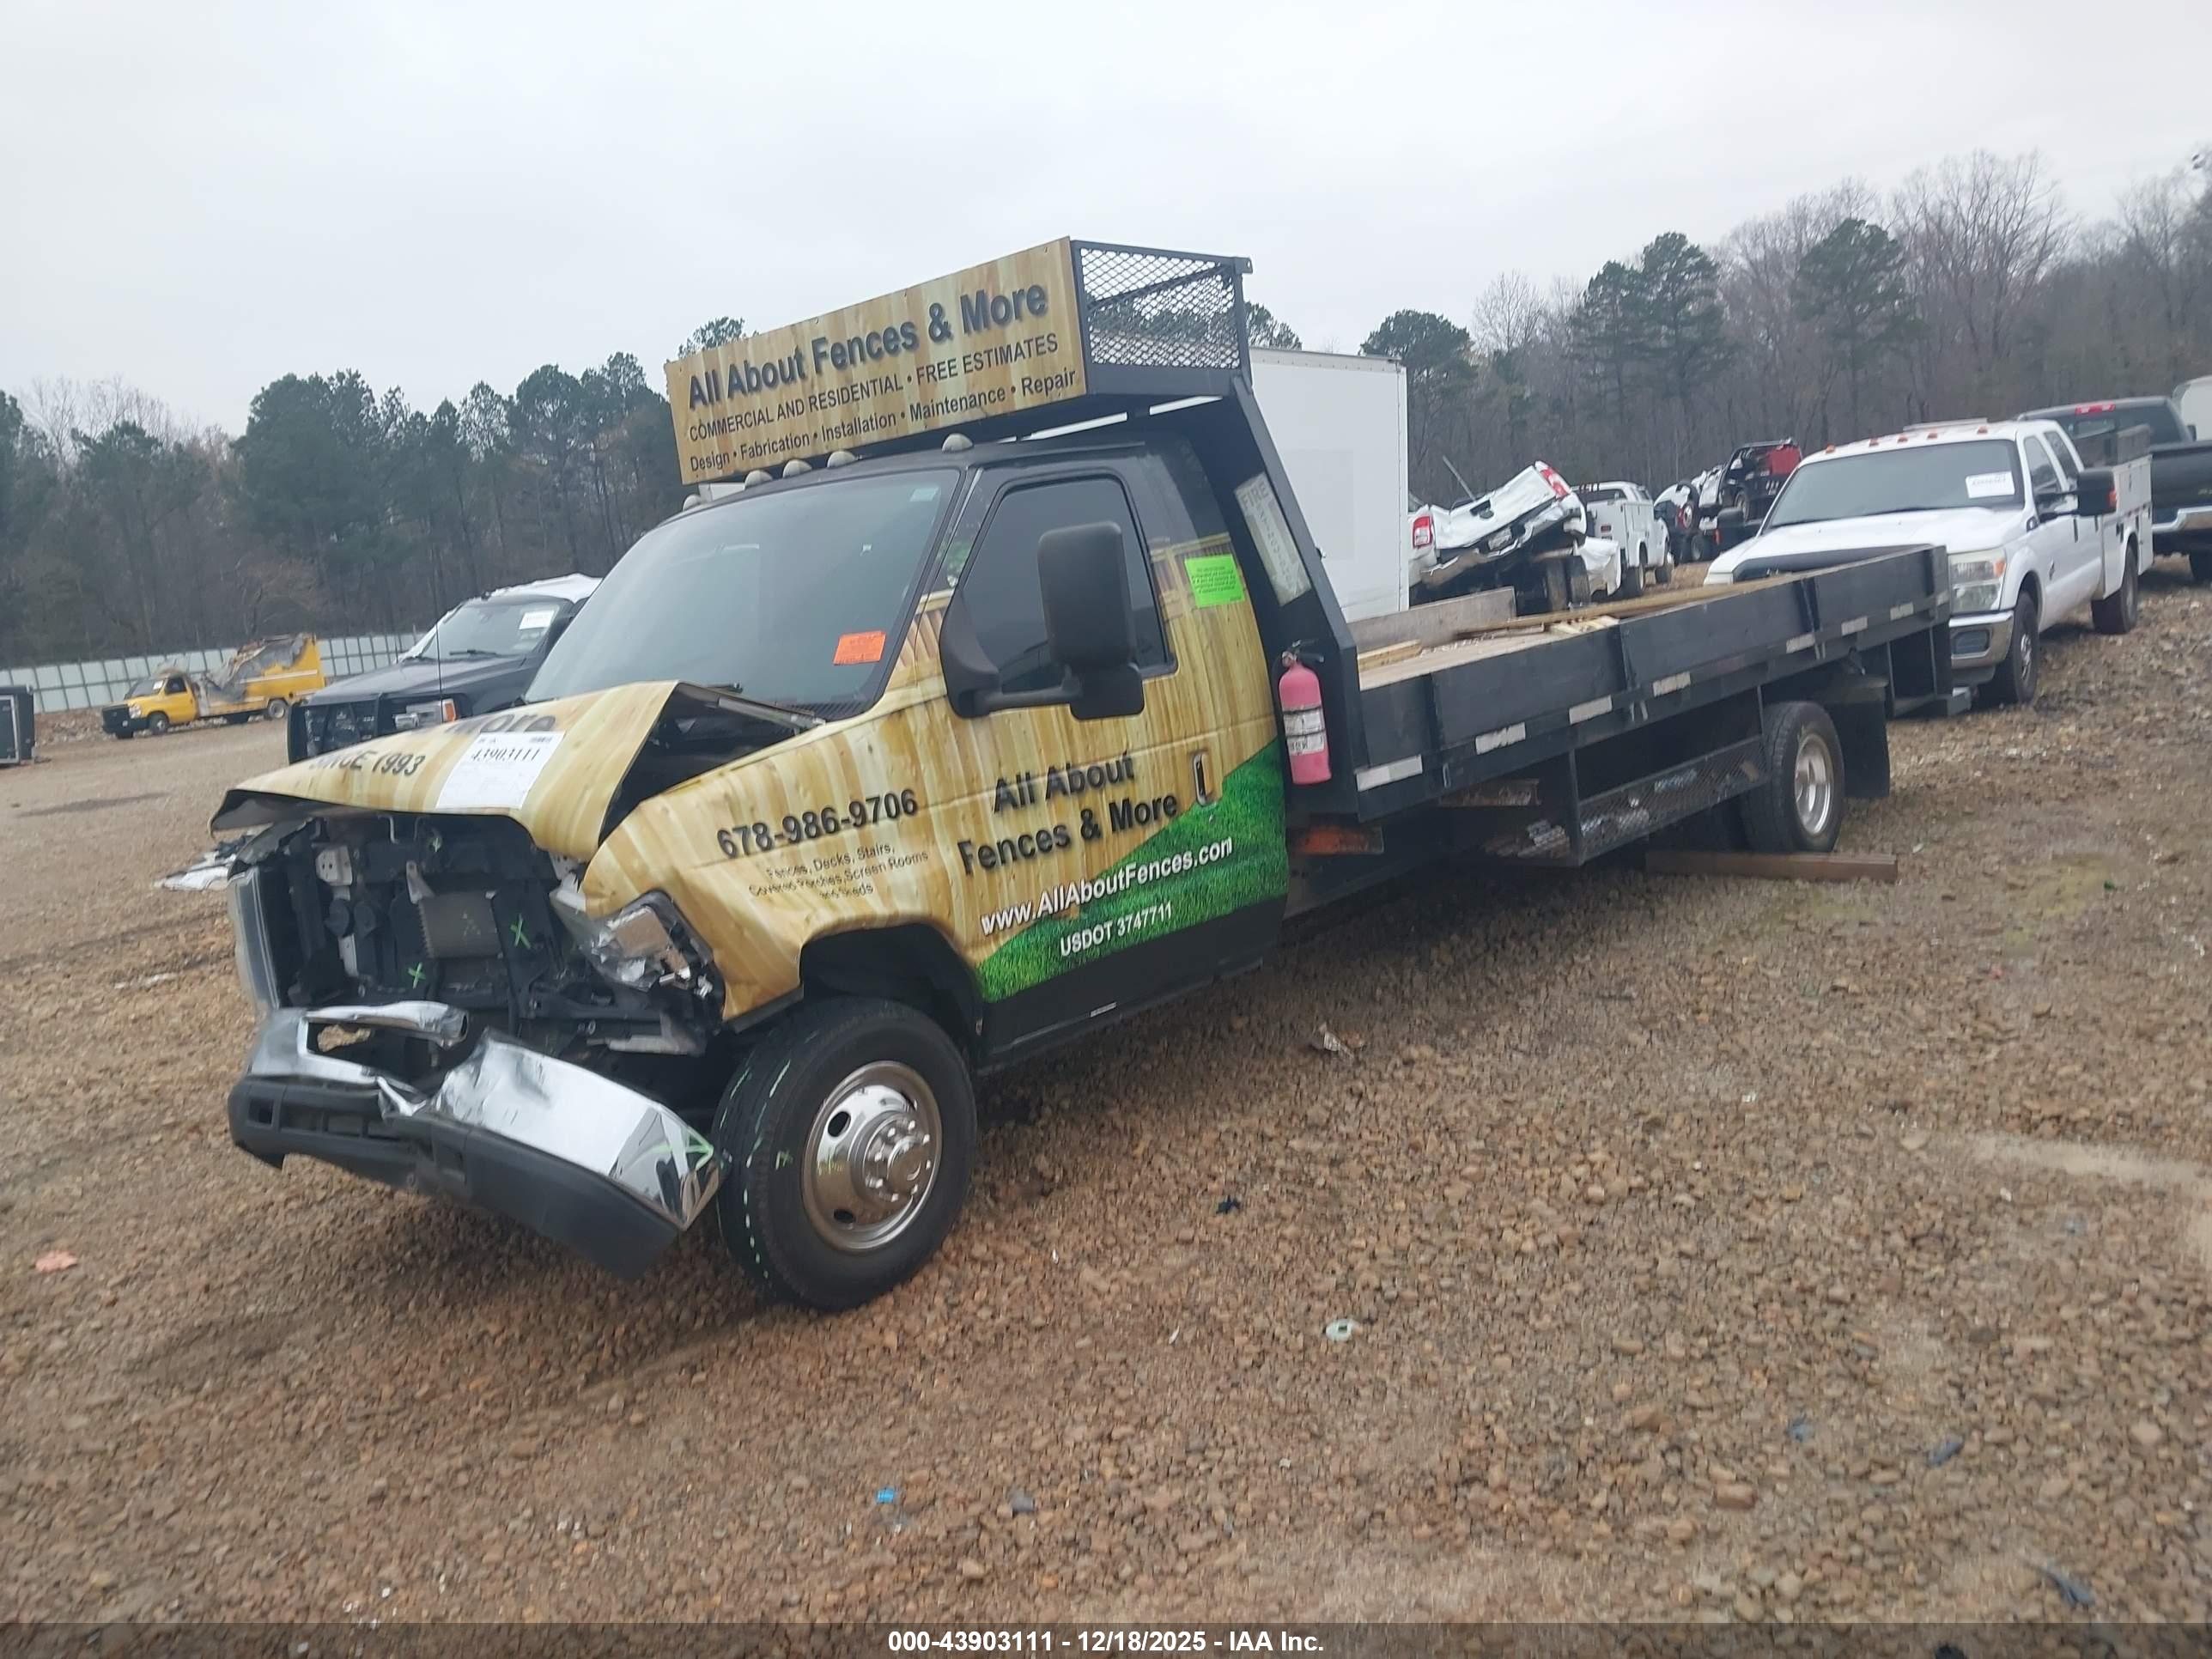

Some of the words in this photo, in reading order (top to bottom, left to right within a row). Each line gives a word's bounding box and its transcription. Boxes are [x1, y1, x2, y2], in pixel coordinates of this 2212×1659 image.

[690, 369, 721, 410] All
[727, 345, 807, 399] About
[811, 321, 920, 374] Fences
[928, 302, 954, 343] &
[960, 284, 1048, 335] More
[690, 409, 774, 442] COMMERCIAL
[777, 398, 805, 421] AND
[809, 374, 903, 413] RESIDENTIAL
[916, 357, 958, 386] FREE
[963, 332, 1059, 374] ESTIMATES
[690, 450, 730, 472] Design
[740, 432, 810, 461] Fabrication
[822, 411, 896, 442] Installation
[910, 387, 1006, 422] Maintenance
[1021, 367, 1076, 397] Repair
[372, 752, 426, 776] 1993
[994, 771, 1036, 814] All
[1045, 753, 1134, 800] About
[717, 788, 918, 859] 678-986-9706
[813, 854, 855, 872] Decks,
[857, 842, 895, 860] Stairs,
[957, 823, 1072, 875] Fences
[1080, 809, 1101, 841] &
[1109, 793, 1178, 834] More
[888, 851, 928, 869] Rooms
[981, 836, 1233, 936] www.AllAboutFences.com
[1060, 920, 1115, 957] USDOT
[1116, 902, 1173, 937] 3747711
